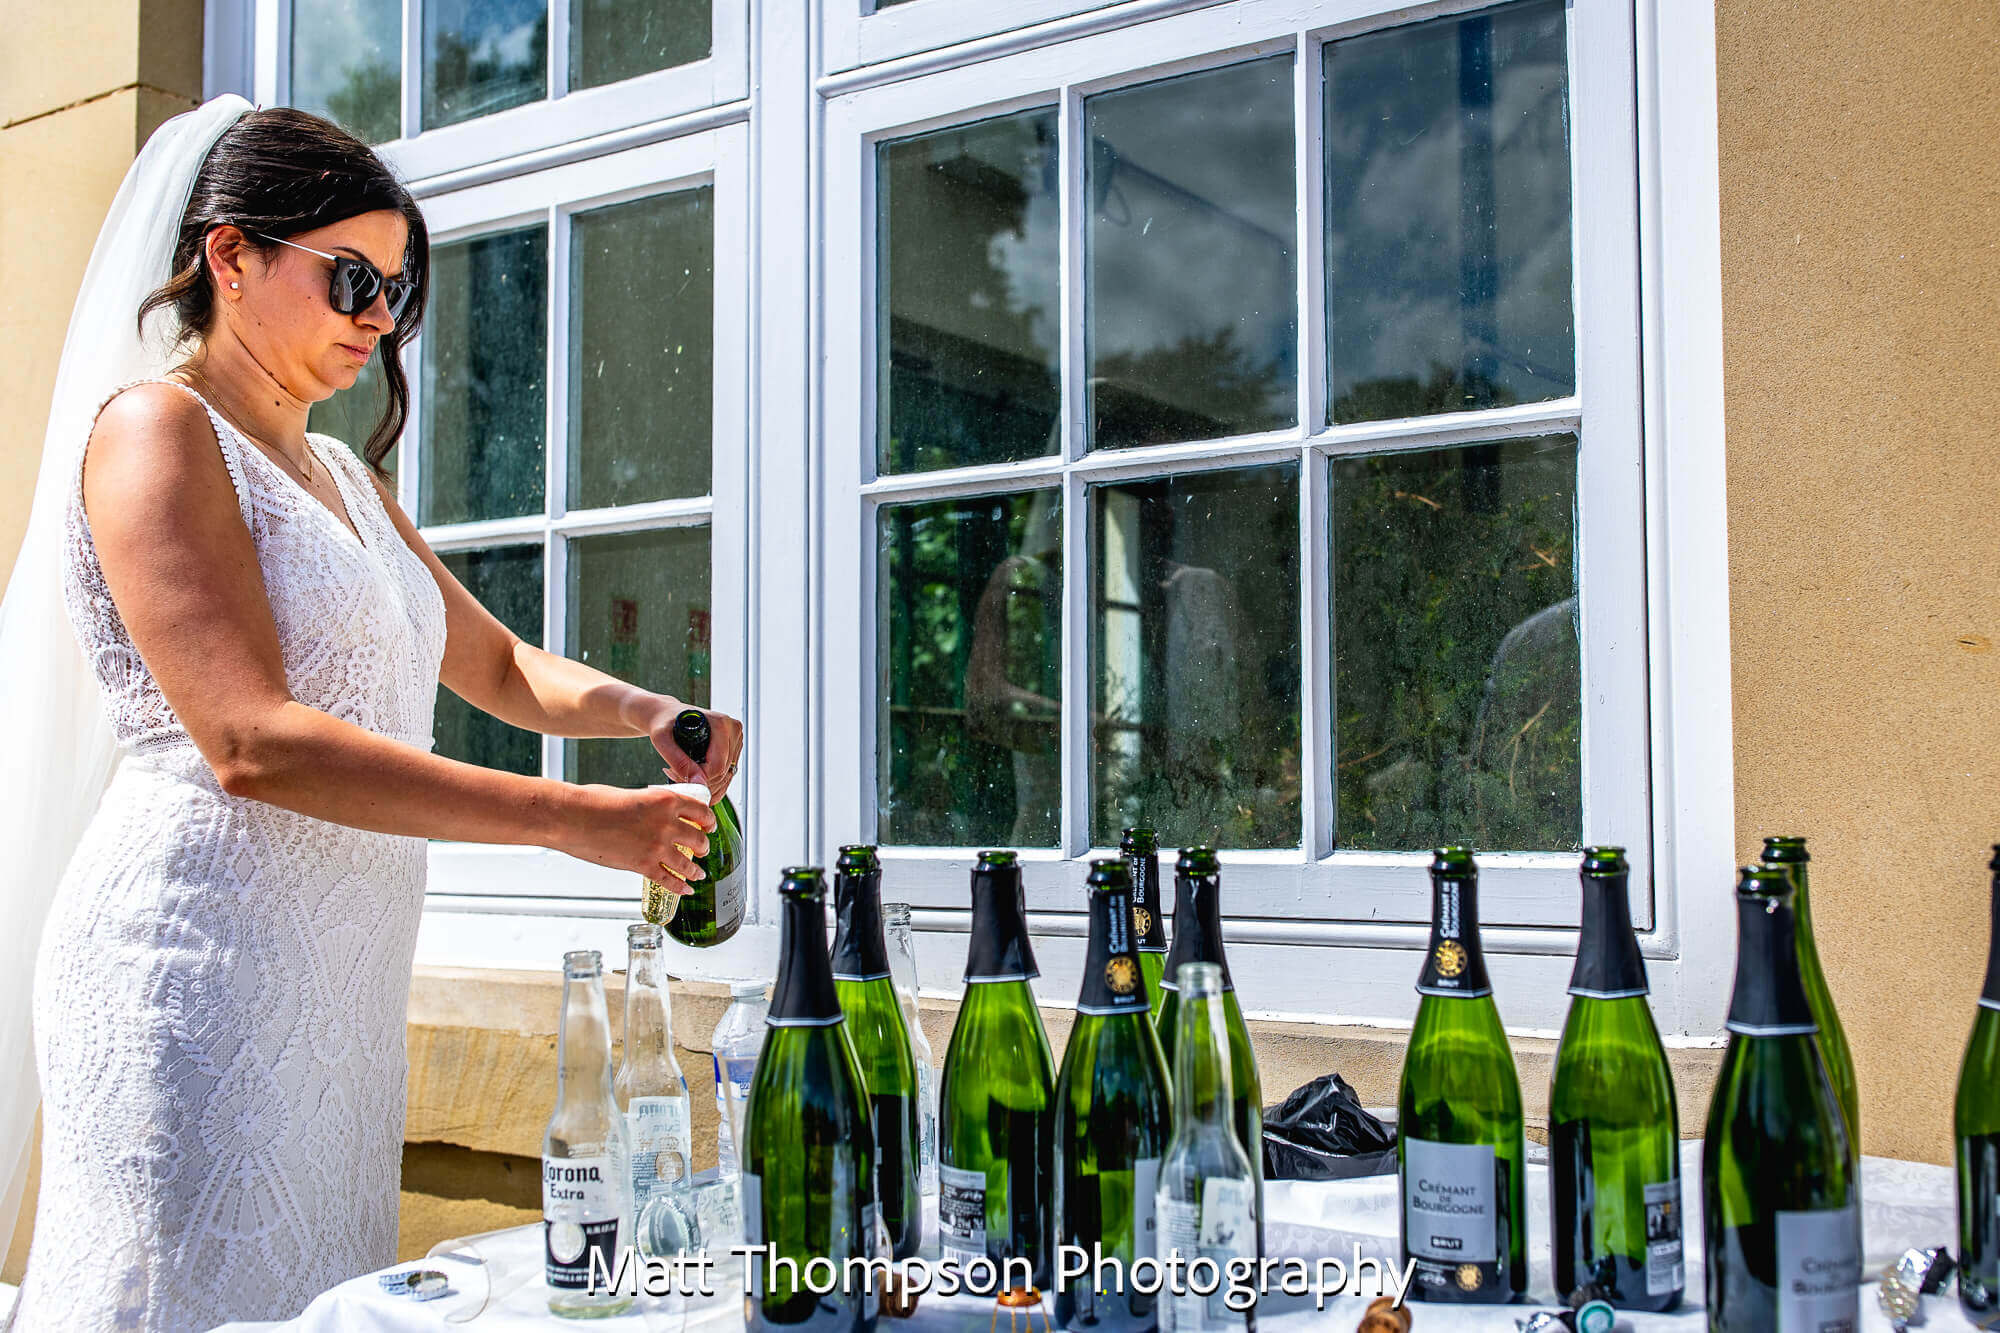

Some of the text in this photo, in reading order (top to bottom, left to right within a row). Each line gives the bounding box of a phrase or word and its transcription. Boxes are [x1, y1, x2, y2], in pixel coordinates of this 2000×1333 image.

[1137, 857, 1146, 903] BOURGOGNE
[551, 1183, 585, 1200] Extra
[1418, 1179, 1477, 1196] CRÉMANT
[1412, 1195, 1485, 1215] BOURGOGNE
[1431, 1238, 1461, 1249] BRUT
